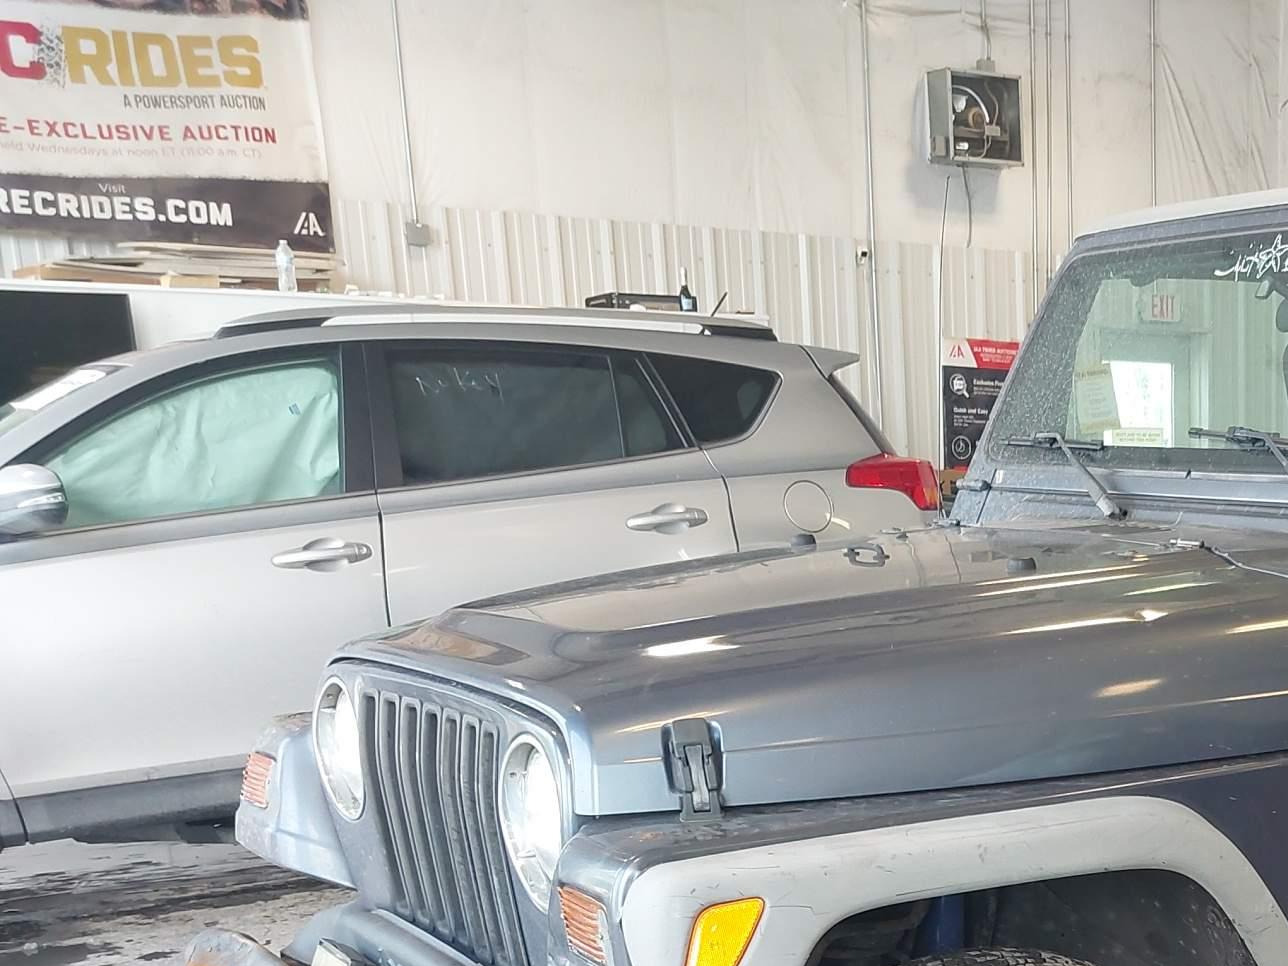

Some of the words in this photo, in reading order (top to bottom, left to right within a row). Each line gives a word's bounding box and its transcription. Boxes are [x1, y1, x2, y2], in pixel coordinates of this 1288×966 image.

[61, 25, 265, 89] RIDES
[123, 95, 133, 108] A
[135, 95, 216, 109] POWERSPORT
[219, 95, 266, 111] AUCTION
[182, 124, 277, 144] AUCTION
[98, 183, 127, 194] Visit
[1151, 294, 1175, 319] EXIT
